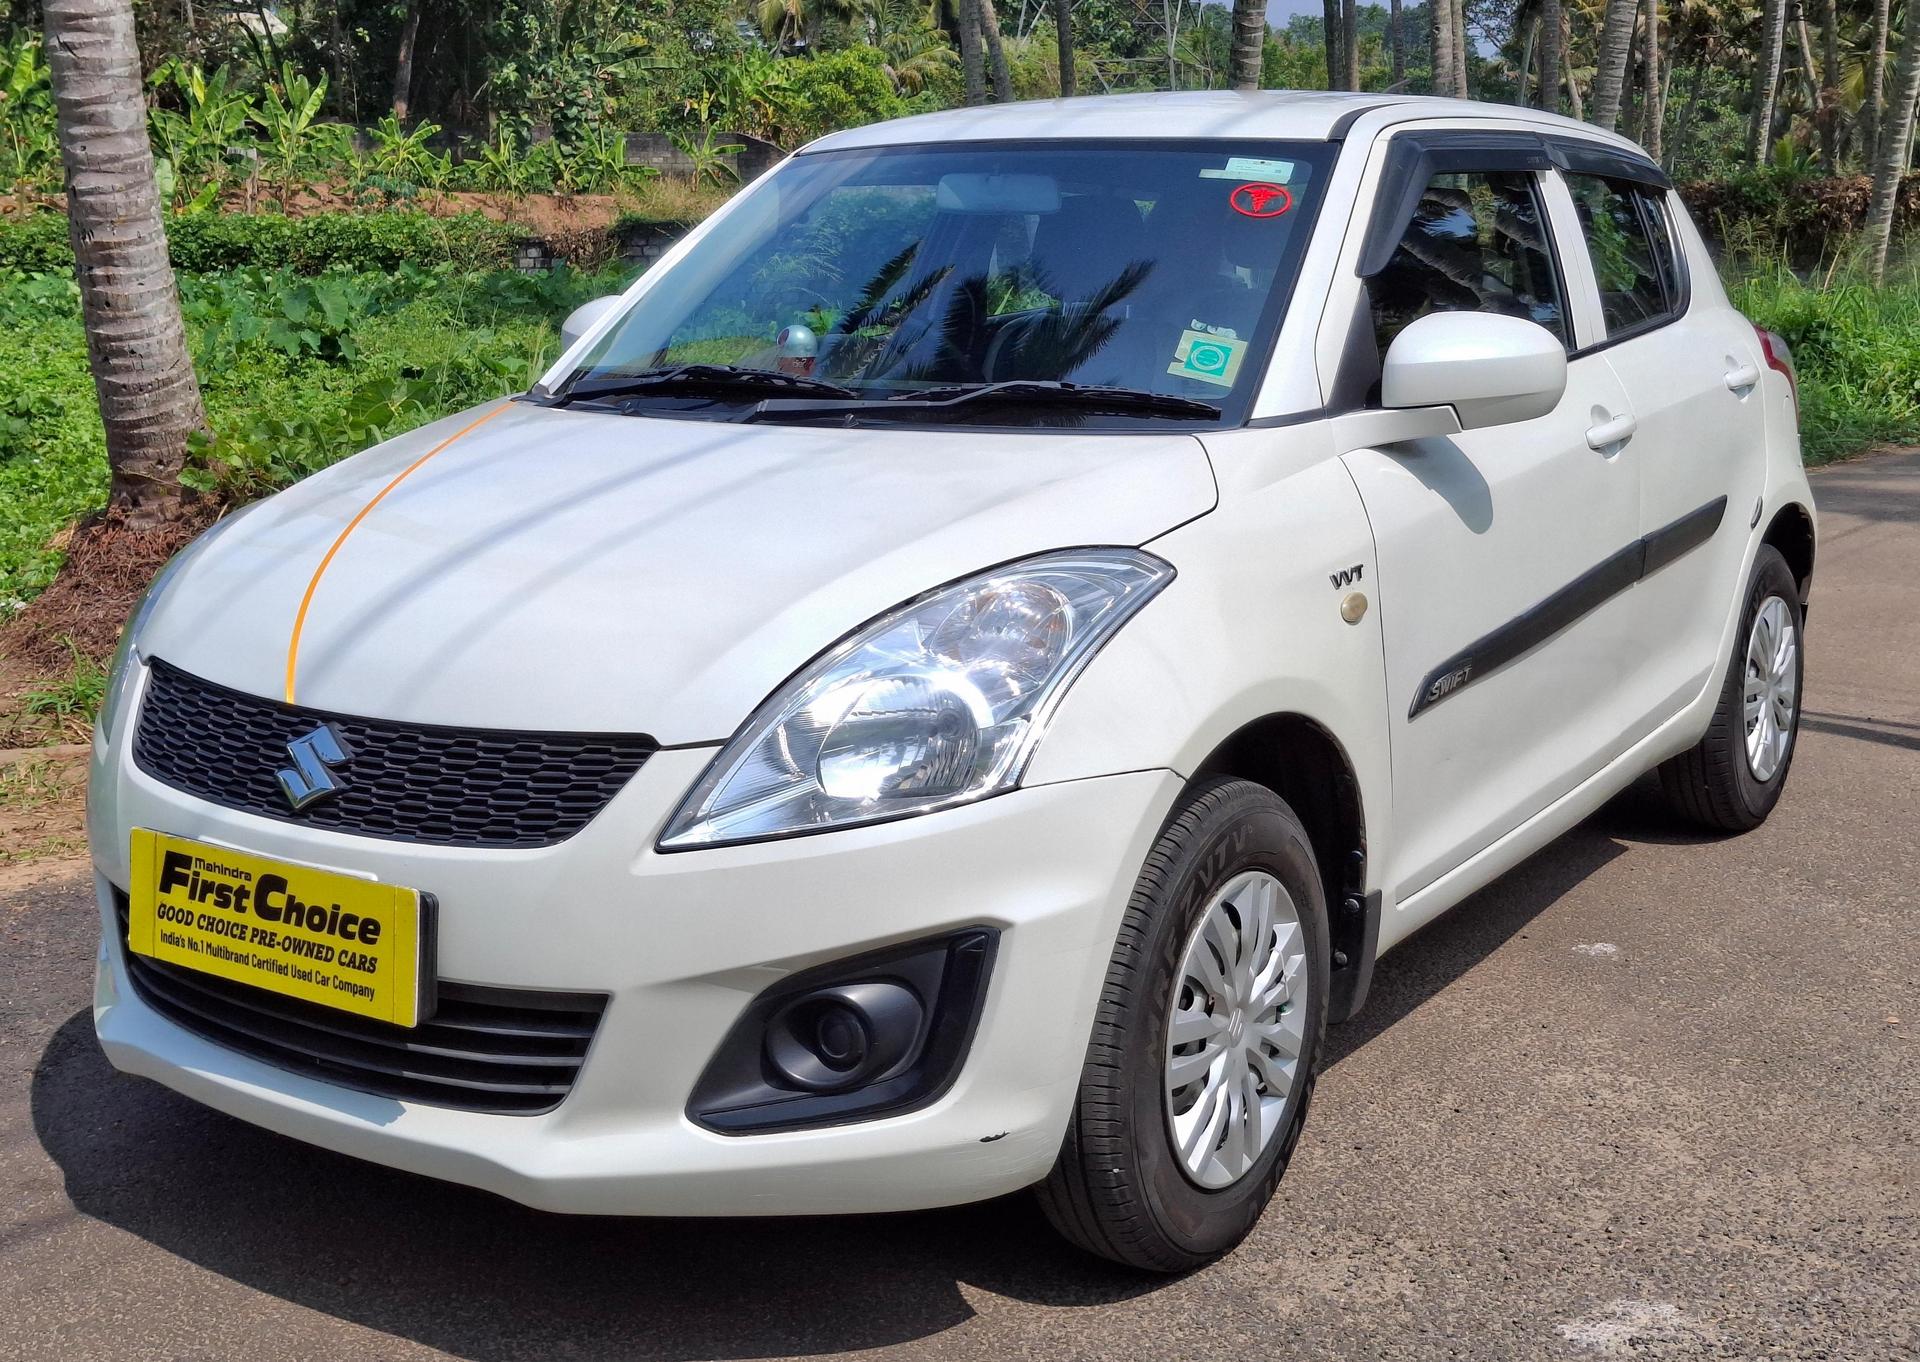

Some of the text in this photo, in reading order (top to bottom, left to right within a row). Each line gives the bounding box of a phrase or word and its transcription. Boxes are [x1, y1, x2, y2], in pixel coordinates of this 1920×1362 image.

[1329, 564, 1364, 590] VVT
[1427, 665, 1473, 701] SWIFT
[194, 857, 252, 881] Mahindra
[159, 850, 381, 945] First Choice
[157, 903, 378, 974] GOOD CHOICE PRE-OWNED CARS
[160, 929, 375, 1002] India's No.1 Multibrand Certified Used Car Company
